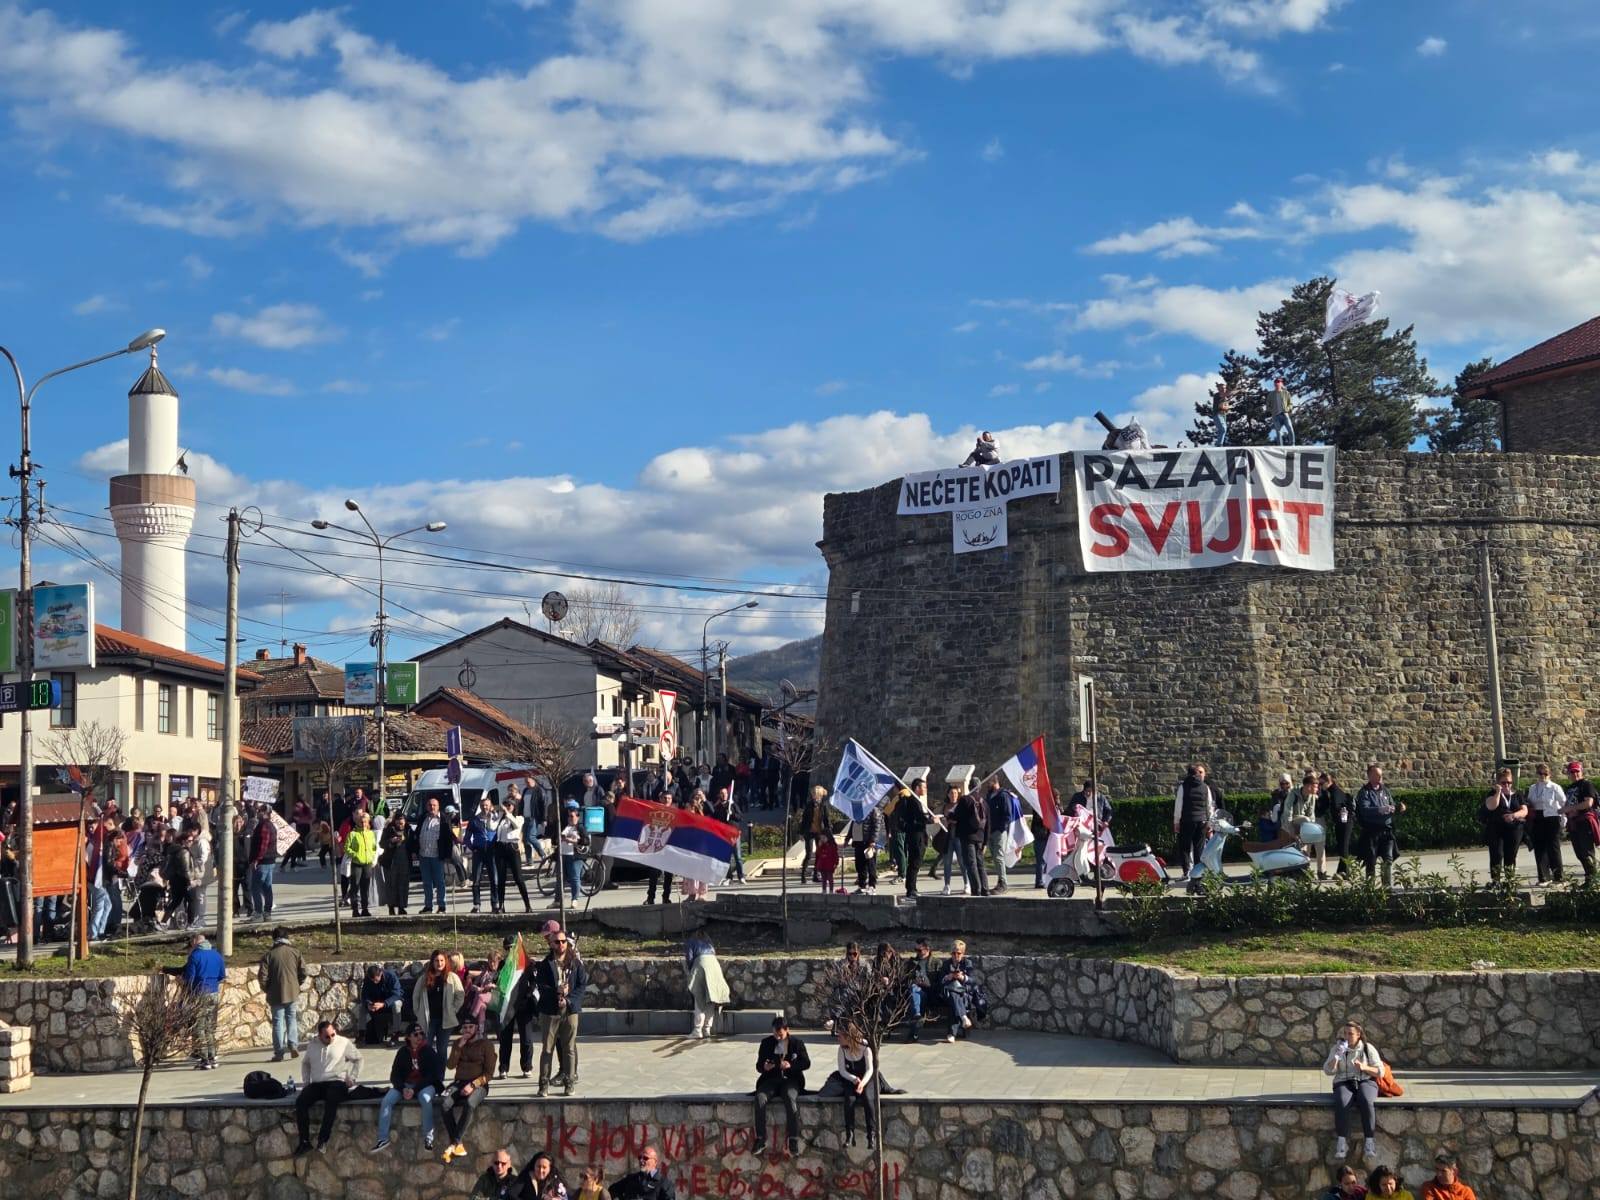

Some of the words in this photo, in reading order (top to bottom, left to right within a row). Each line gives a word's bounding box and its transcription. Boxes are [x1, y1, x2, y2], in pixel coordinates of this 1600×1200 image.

[905, 473, 980, 508] NEĆETE
[983, 460, 1051, 499] KOPATI
[1083, 449, 1256, 491] PAZAR
[1270, 451, 1324, 490] JE
[1089, 498, 1324, 558] SVIJET
